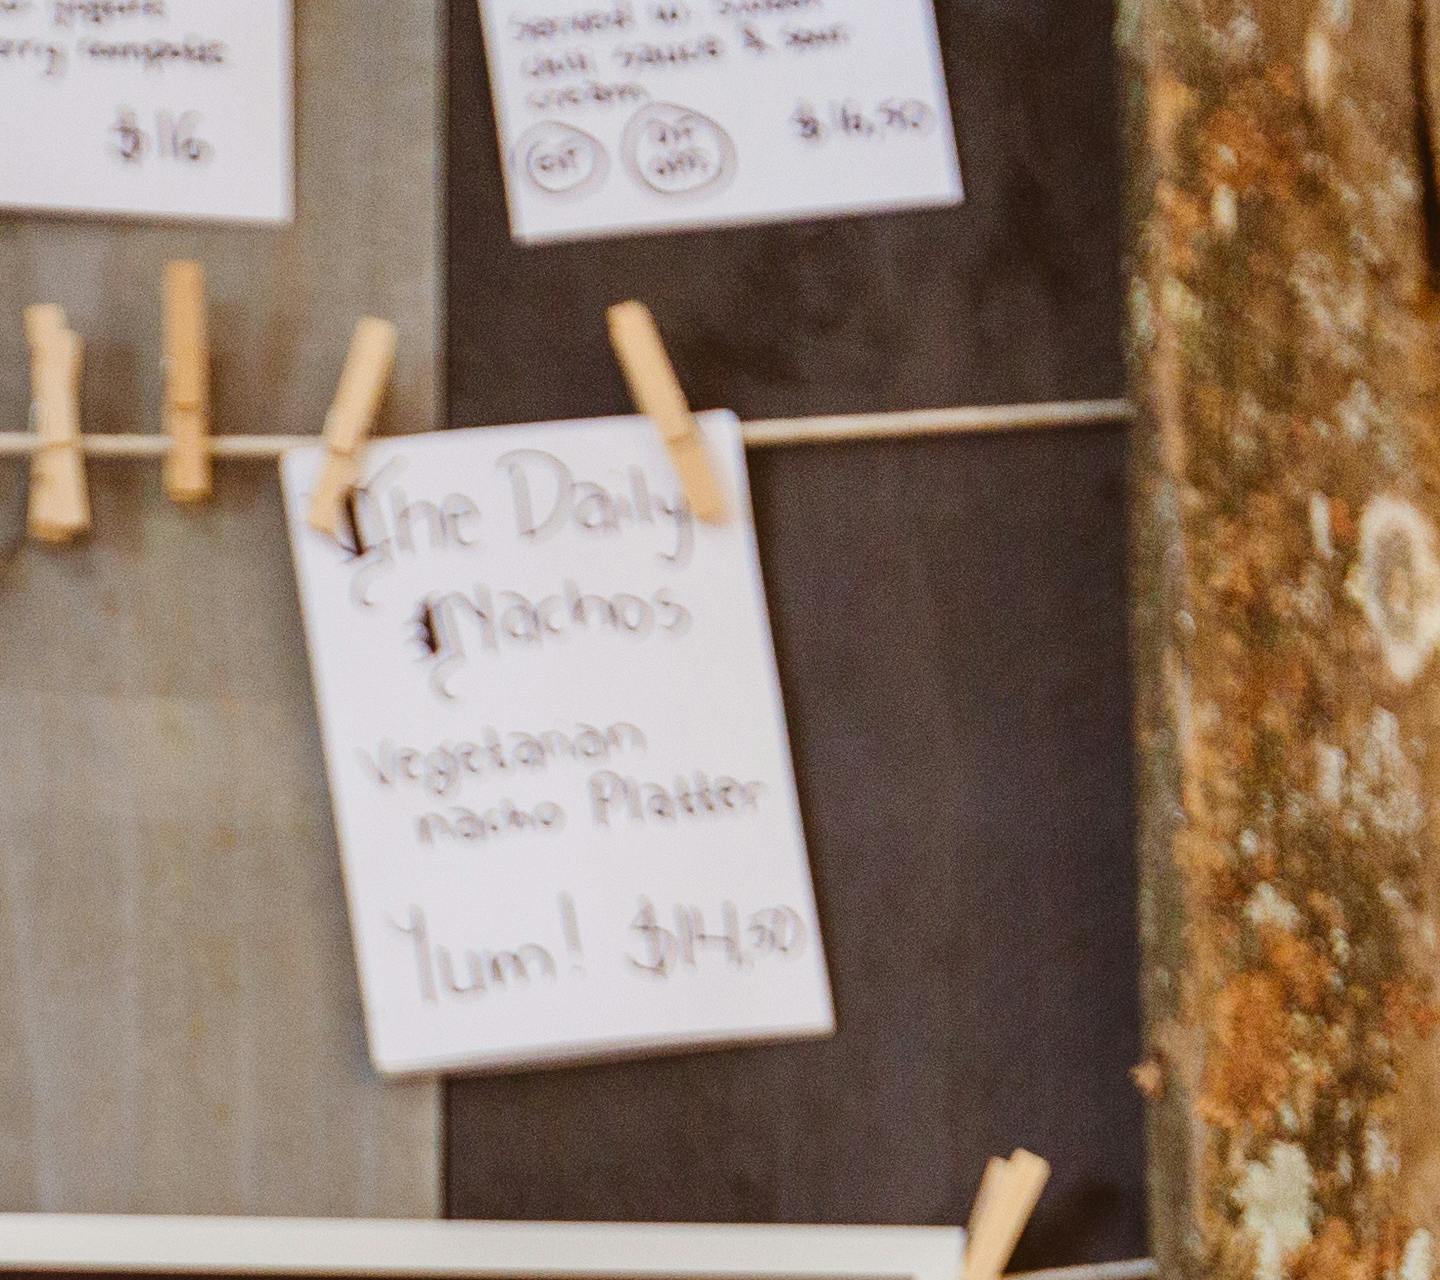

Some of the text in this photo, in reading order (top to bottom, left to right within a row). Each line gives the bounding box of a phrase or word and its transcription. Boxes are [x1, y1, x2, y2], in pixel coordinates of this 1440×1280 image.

[338, 450, 694, 605] The Daily
[407, 582, 691, 698] Nachos
[591, 771, 764, 825] Platter
[385, 891, 584, 1001] Yum!
